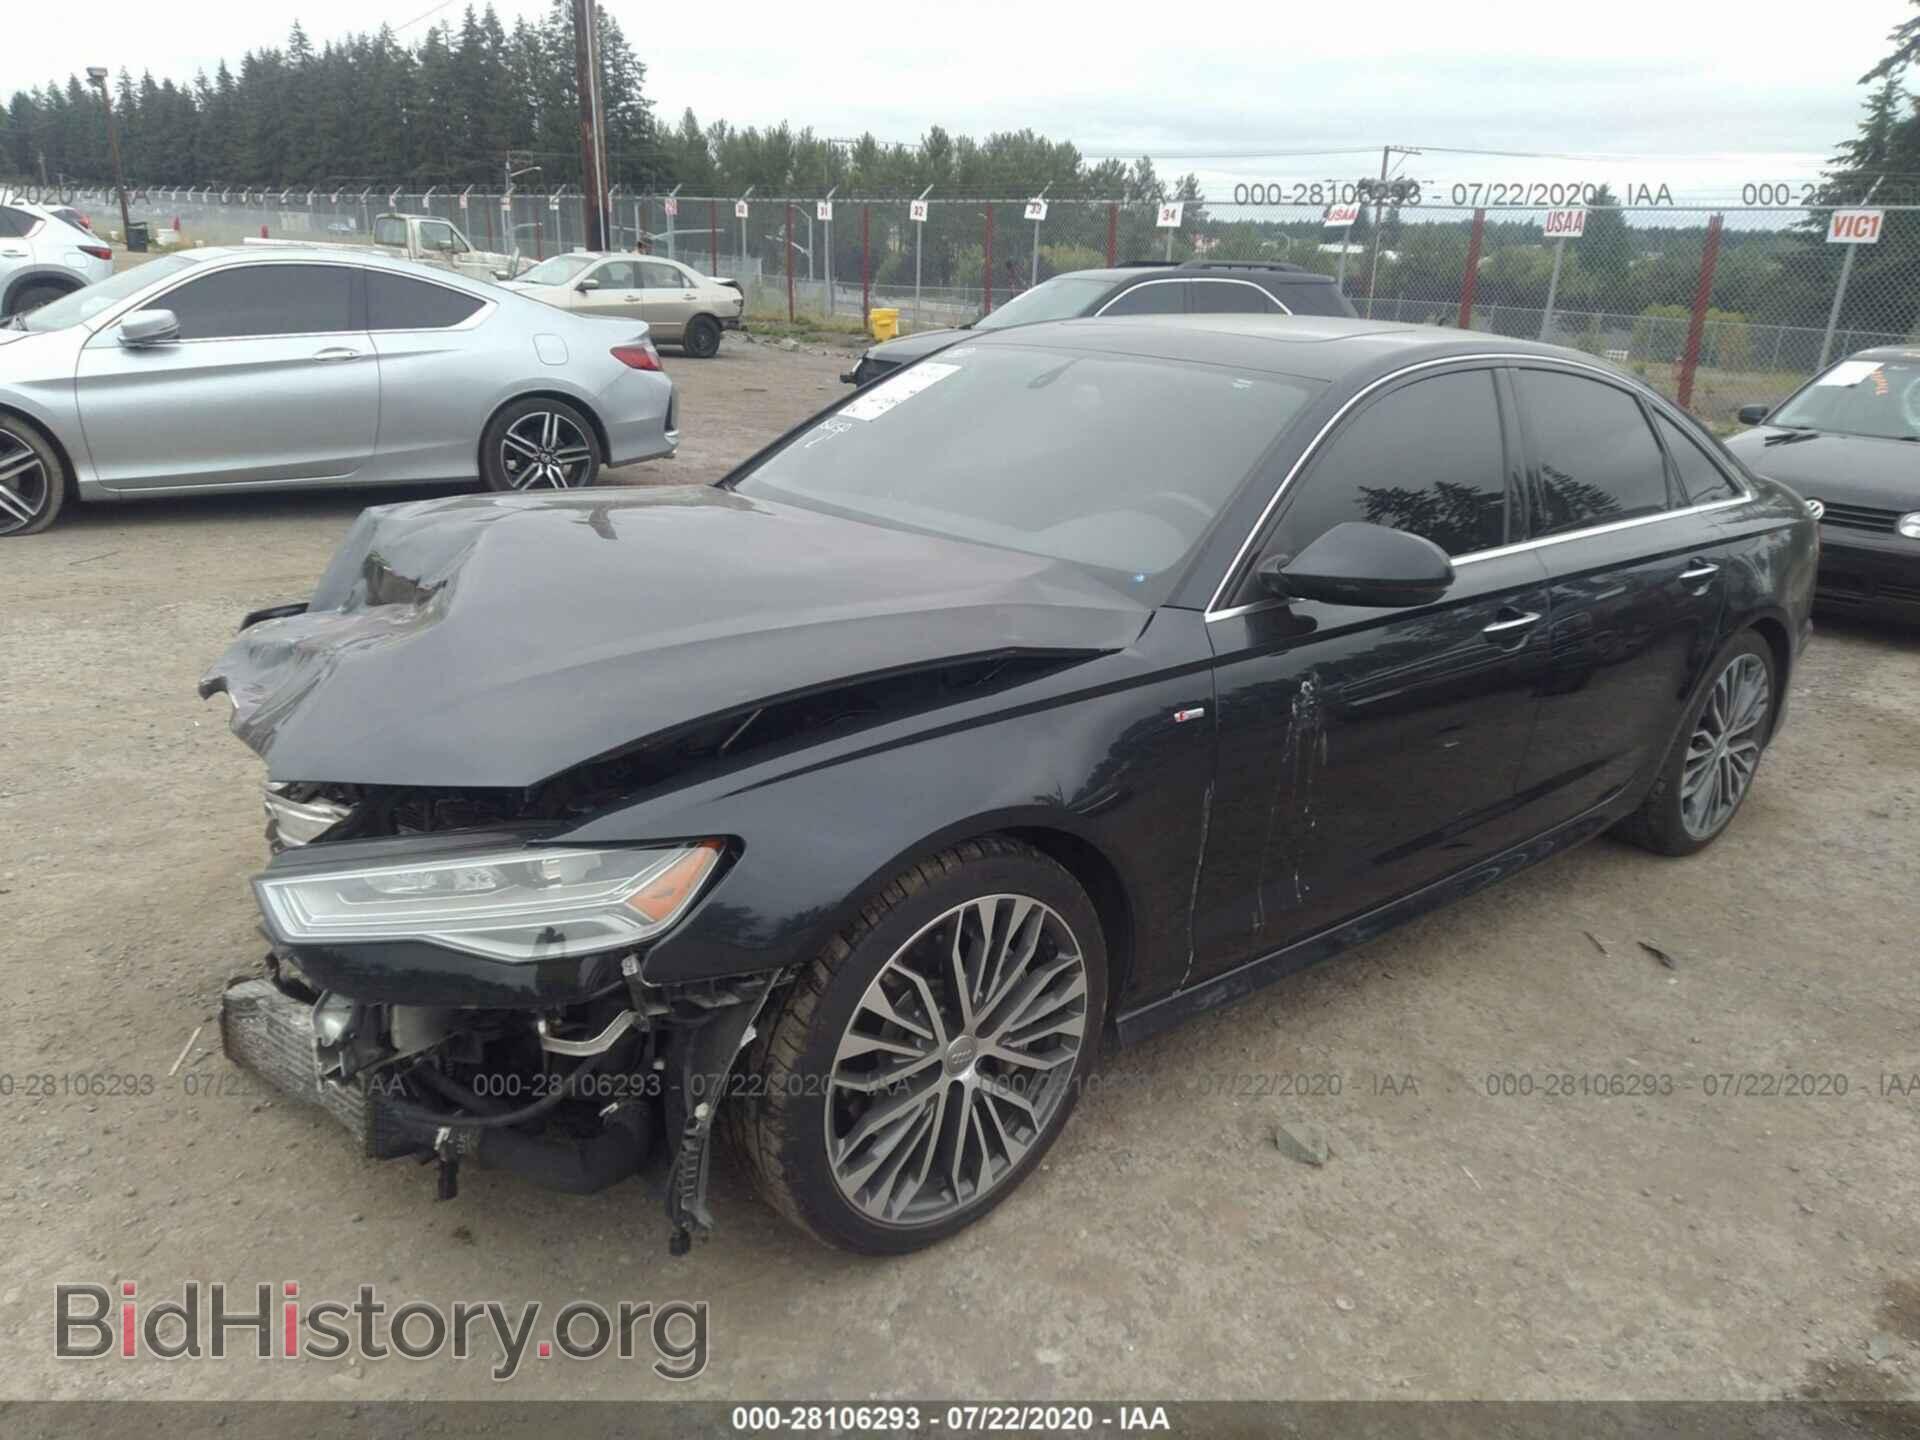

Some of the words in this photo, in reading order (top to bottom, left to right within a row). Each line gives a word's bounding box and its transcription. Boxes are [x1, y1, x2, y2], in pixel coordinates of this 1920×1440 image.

[1162, 208, 1177, 221] 34
[1326, 207, 1358, 222] USAA
[1546, 210, 1584, 233] USAA
[1833, 215, 1879, 238] VIC1
